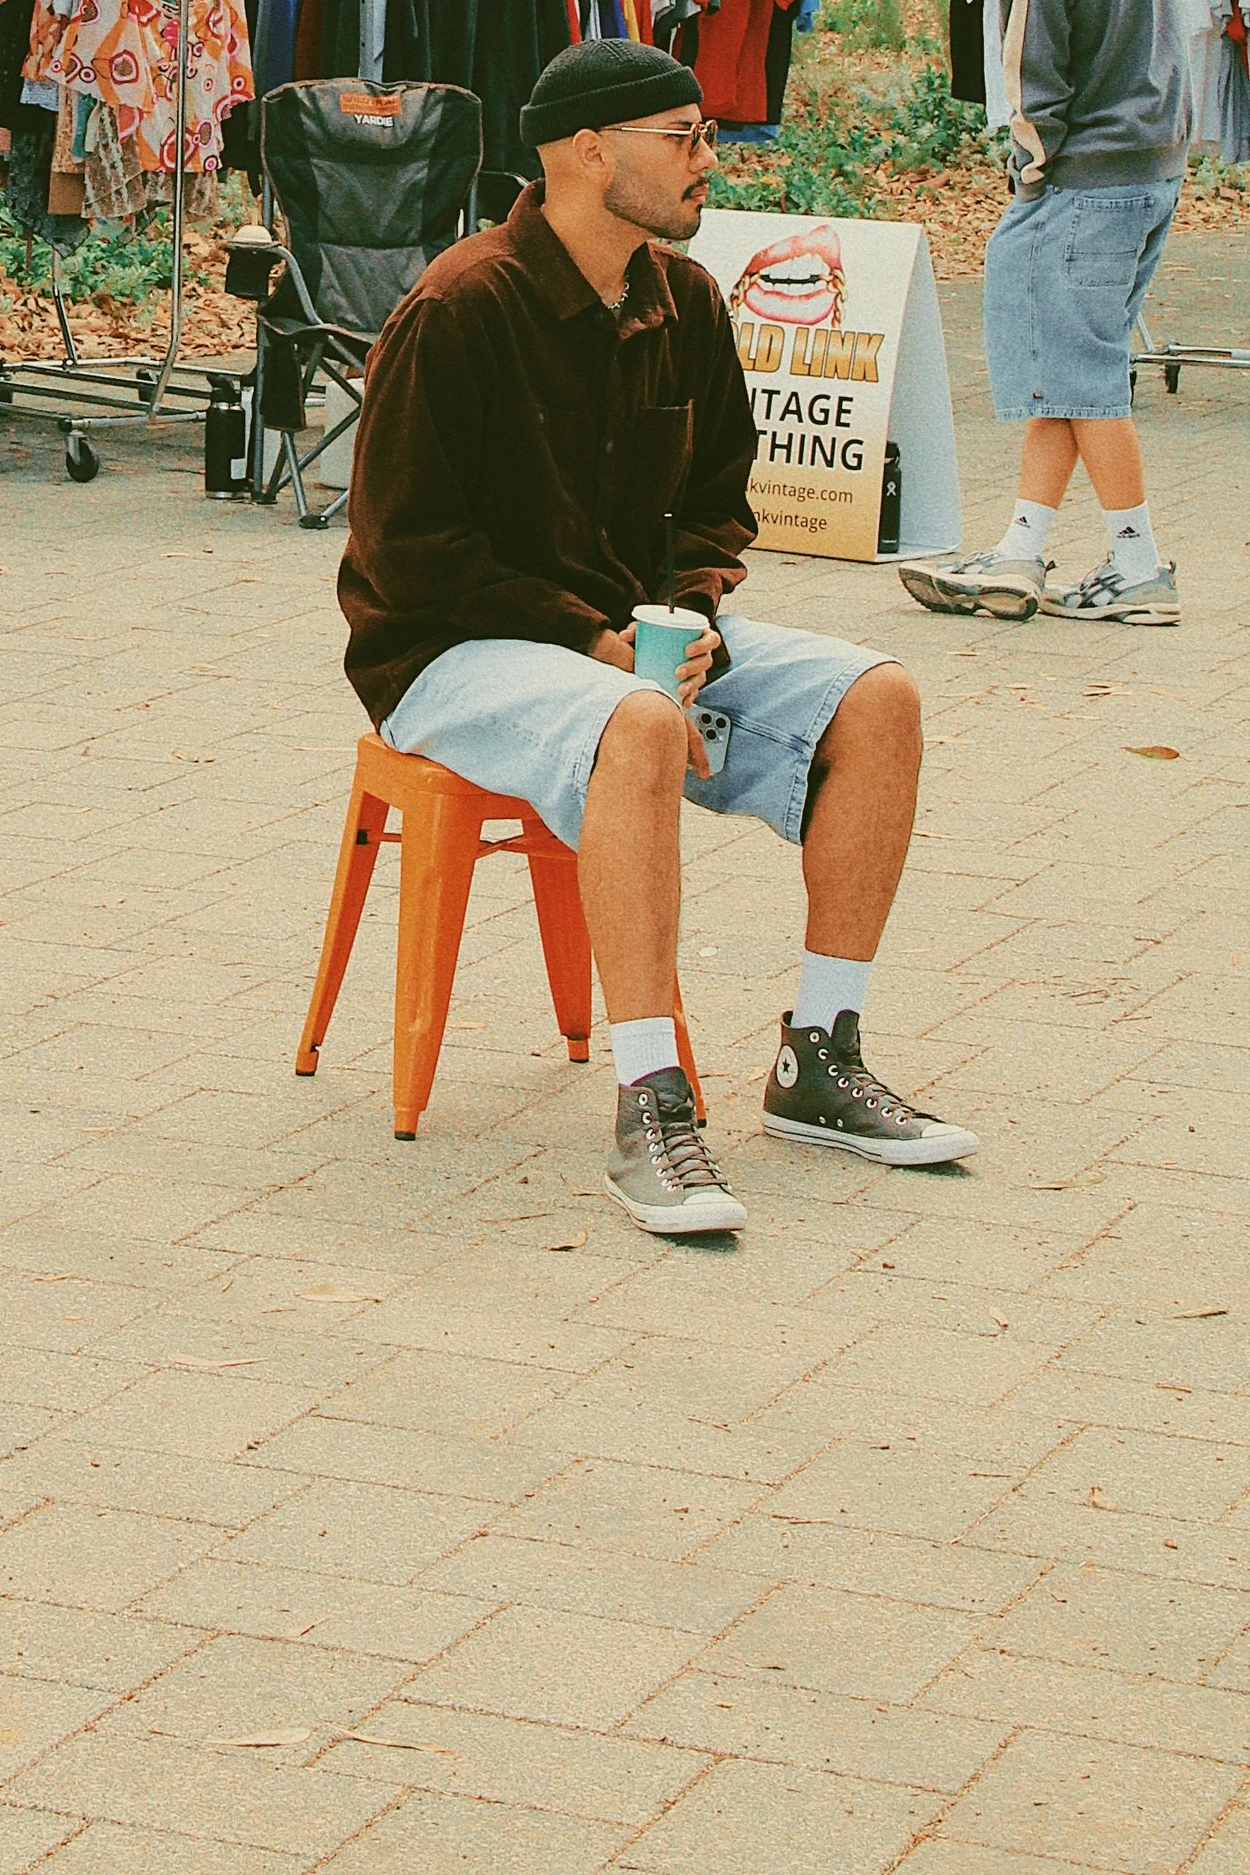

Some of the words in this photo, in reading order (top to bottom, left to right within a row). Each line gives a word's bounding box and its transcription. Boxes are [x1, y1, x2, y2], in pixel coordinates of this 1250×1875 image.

[354, 114, 394, 127] YARDIE
[732, 322, 785, 373] LD
[790, 327, 885, 383] LINK
[750, 387, 854, 428] TAGE
[752, 429, 864, 471] THING
[747, 478, 853, 504] kvintage.com
[753, 508, 828, 533] nkvintage
